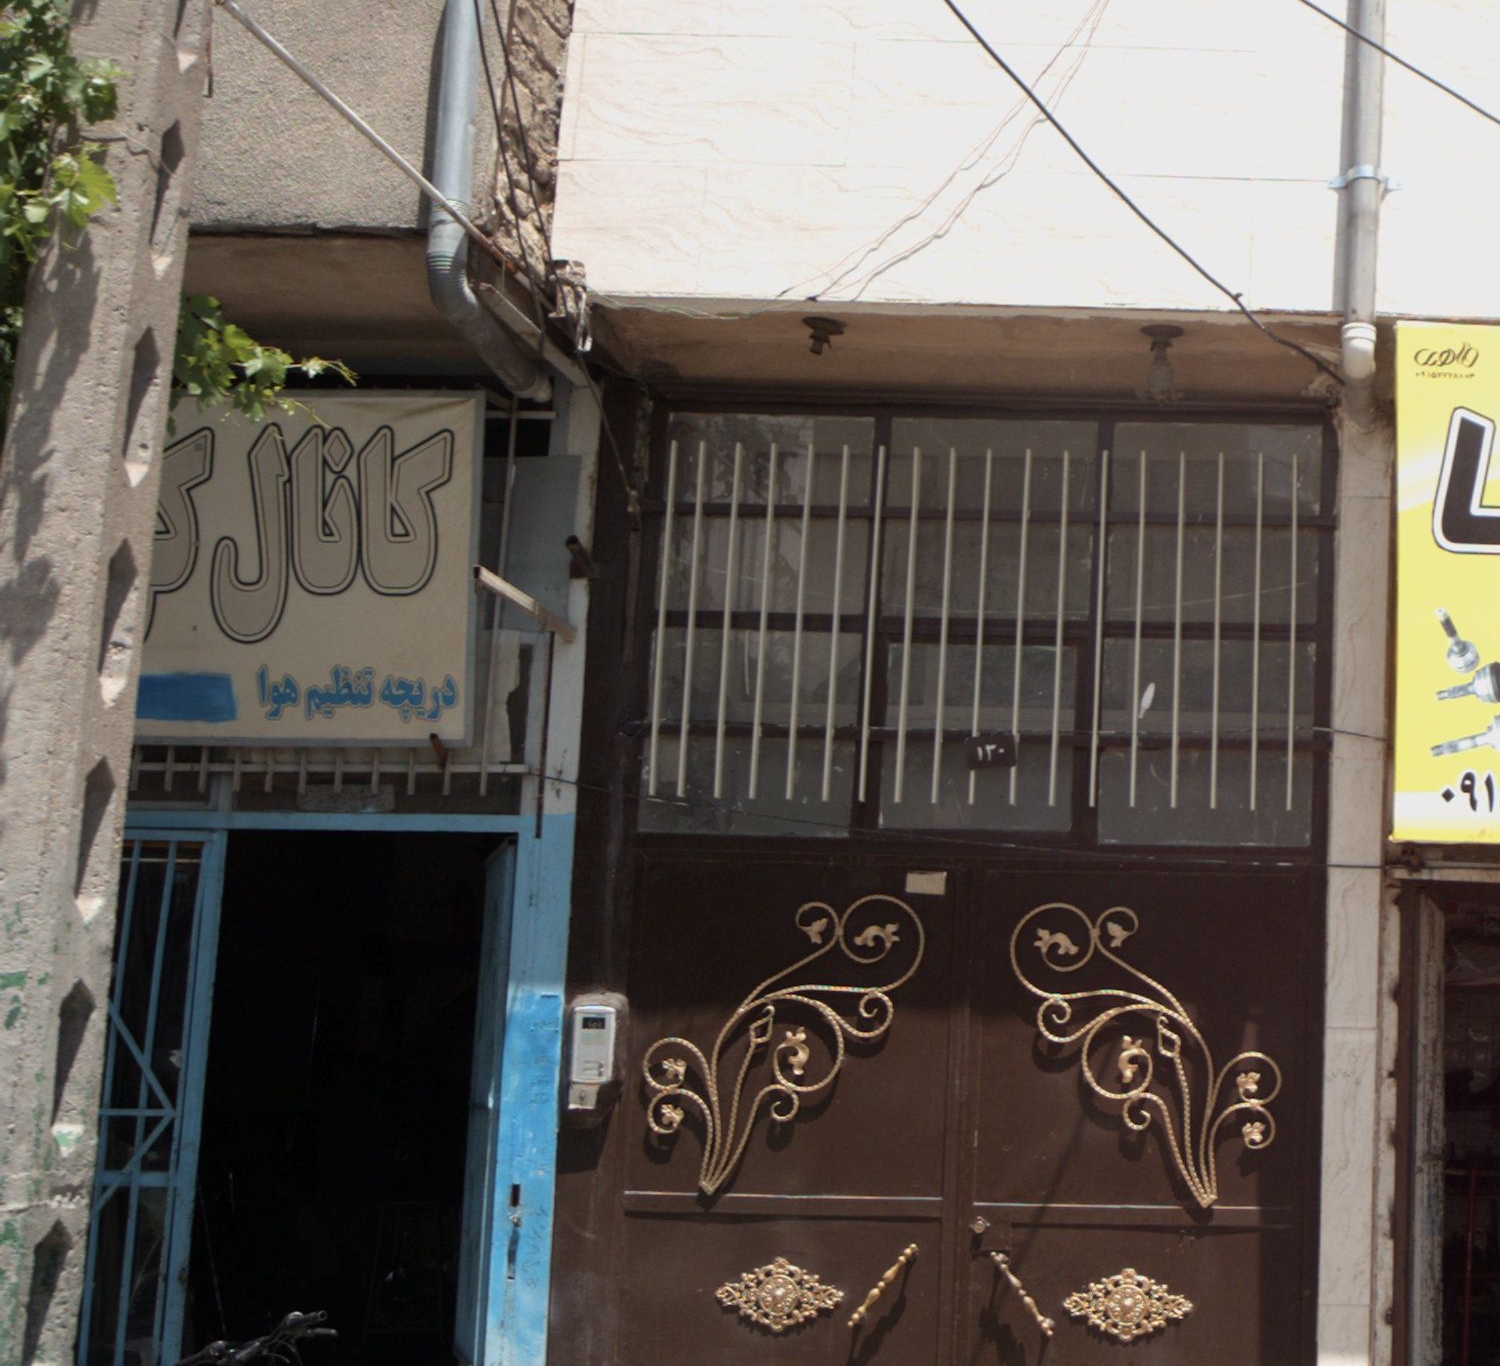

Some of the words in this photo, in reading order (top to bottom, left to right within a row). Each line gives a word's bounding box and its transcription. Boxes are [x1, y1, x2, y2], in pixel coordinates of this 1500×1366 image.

[210, 422, 454, 644] کانال
[256, 663, 300, 720] هوا
[305, 664, 376, 720] تنظیم
[380, 674, 459, 723] دریچه
